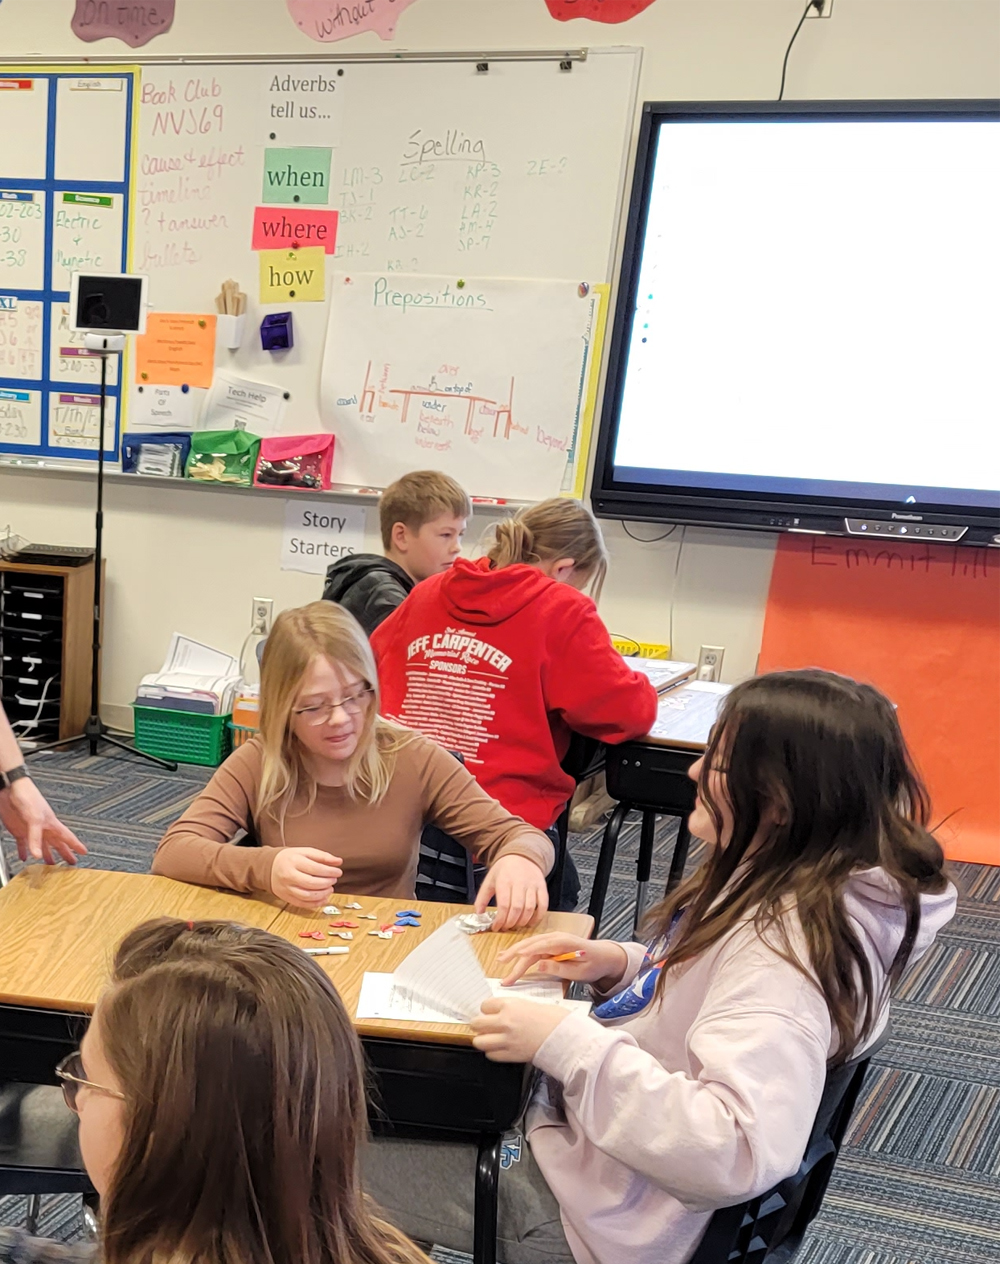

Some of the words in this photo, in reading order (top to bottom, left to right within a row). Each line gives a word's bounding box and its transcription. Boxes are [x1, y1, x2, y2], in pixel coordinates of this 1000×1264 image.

[140, 80, 177, 105] Book
[184, 77, 222, 102] Club
[269, 75, 336, 92] Adverbs
[270, 101, 294, 118] tell
[403, 129, 486, 168] Spelling
[267, 164, 325, 188] when
[262, 216, 328, 240] where
[268, 266, 314, 287] how
[373, 277, 487, 314] Prepositions
[228, 385, 246, 398] Tech
[248, 391, 267, 403] Help
[302, 510, 347, 534] Story
[289, 537, 355, 558] Starters
[432, 633, 513, 673] CARPENTER
[428, 660, 468, 675] SPONSORS
